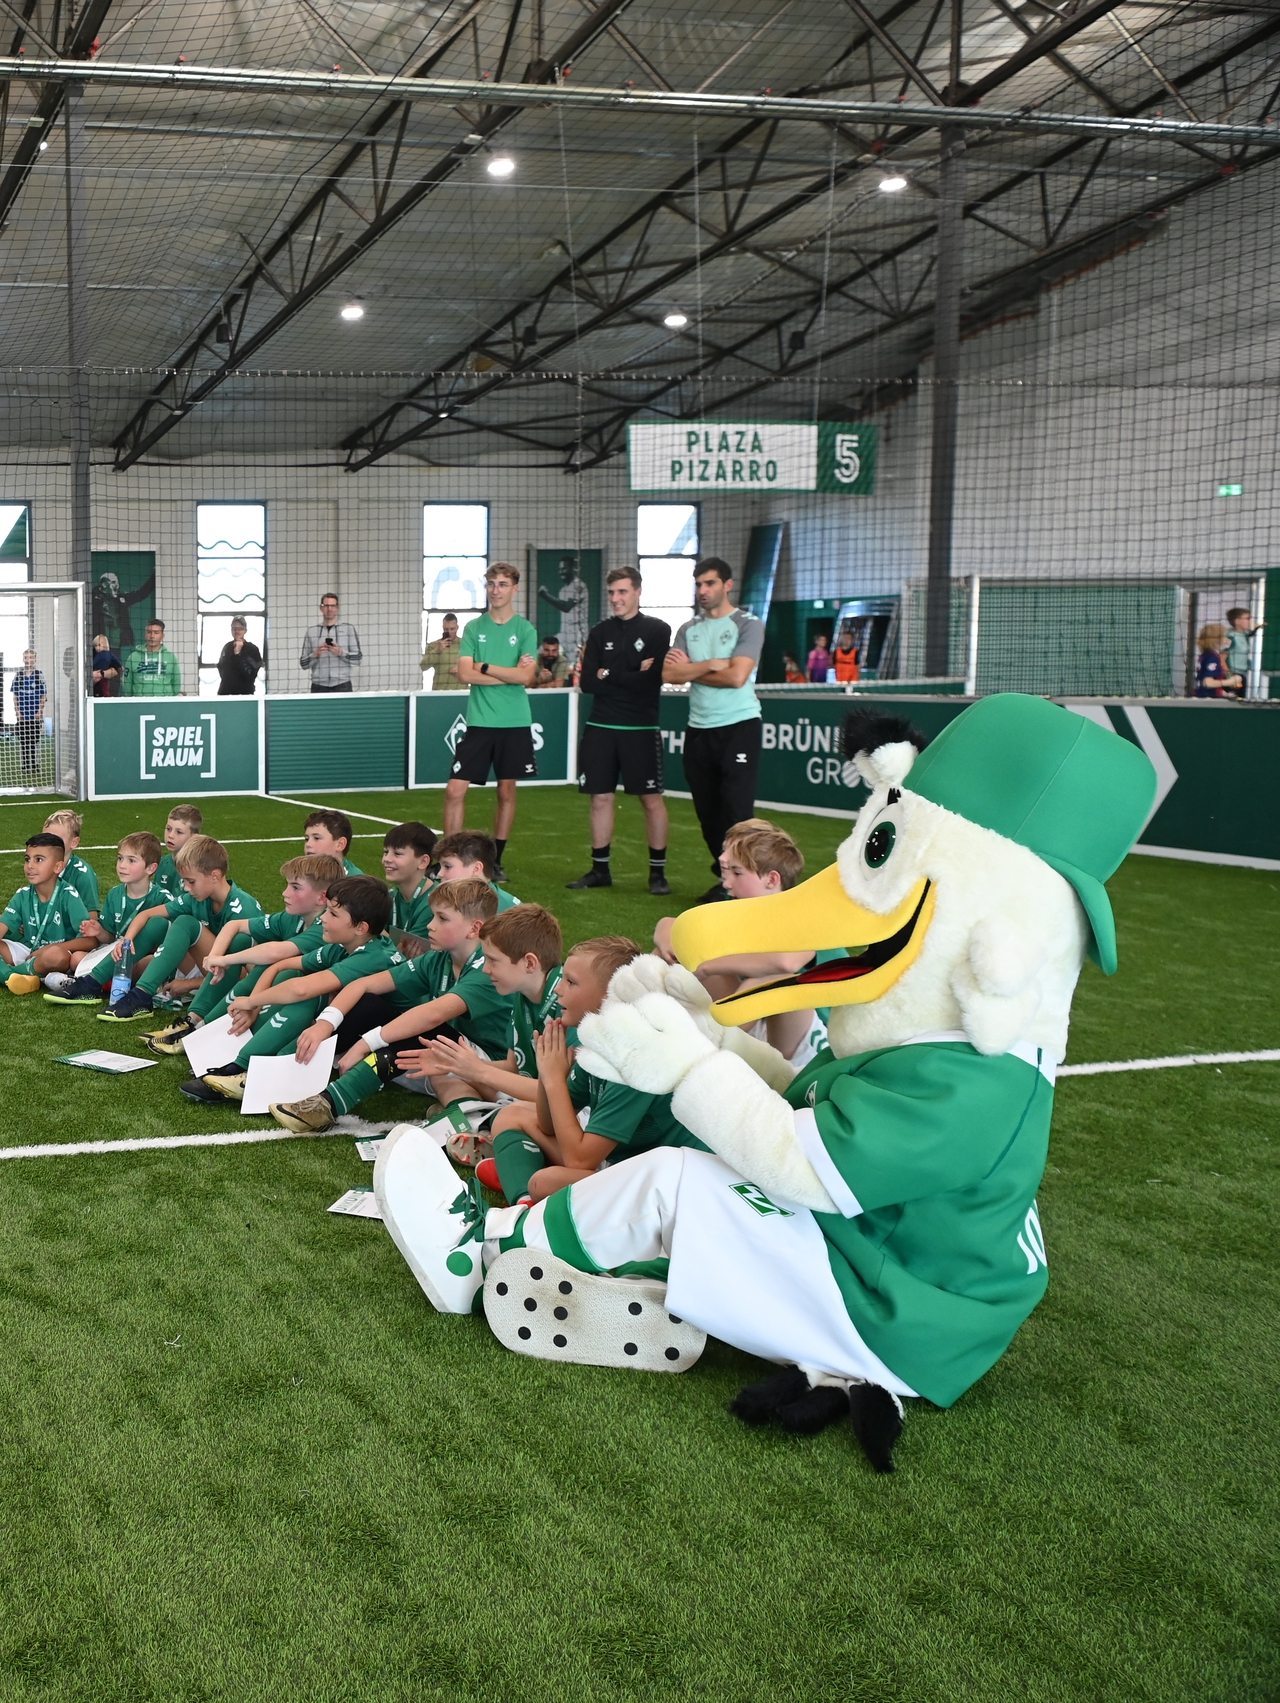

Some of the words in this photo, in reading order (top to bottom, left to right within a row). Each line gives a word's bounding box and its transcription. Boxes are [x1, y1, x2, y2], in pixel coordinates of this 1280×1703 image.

[686, 430, 763, 453] PLAZA
[833, 433, 861, 484] 5
[671, 459, 778, 482] PIZARRO
[152, 726, 204, 747] SPIEL
[151, 747, 204, 767] RAUM
